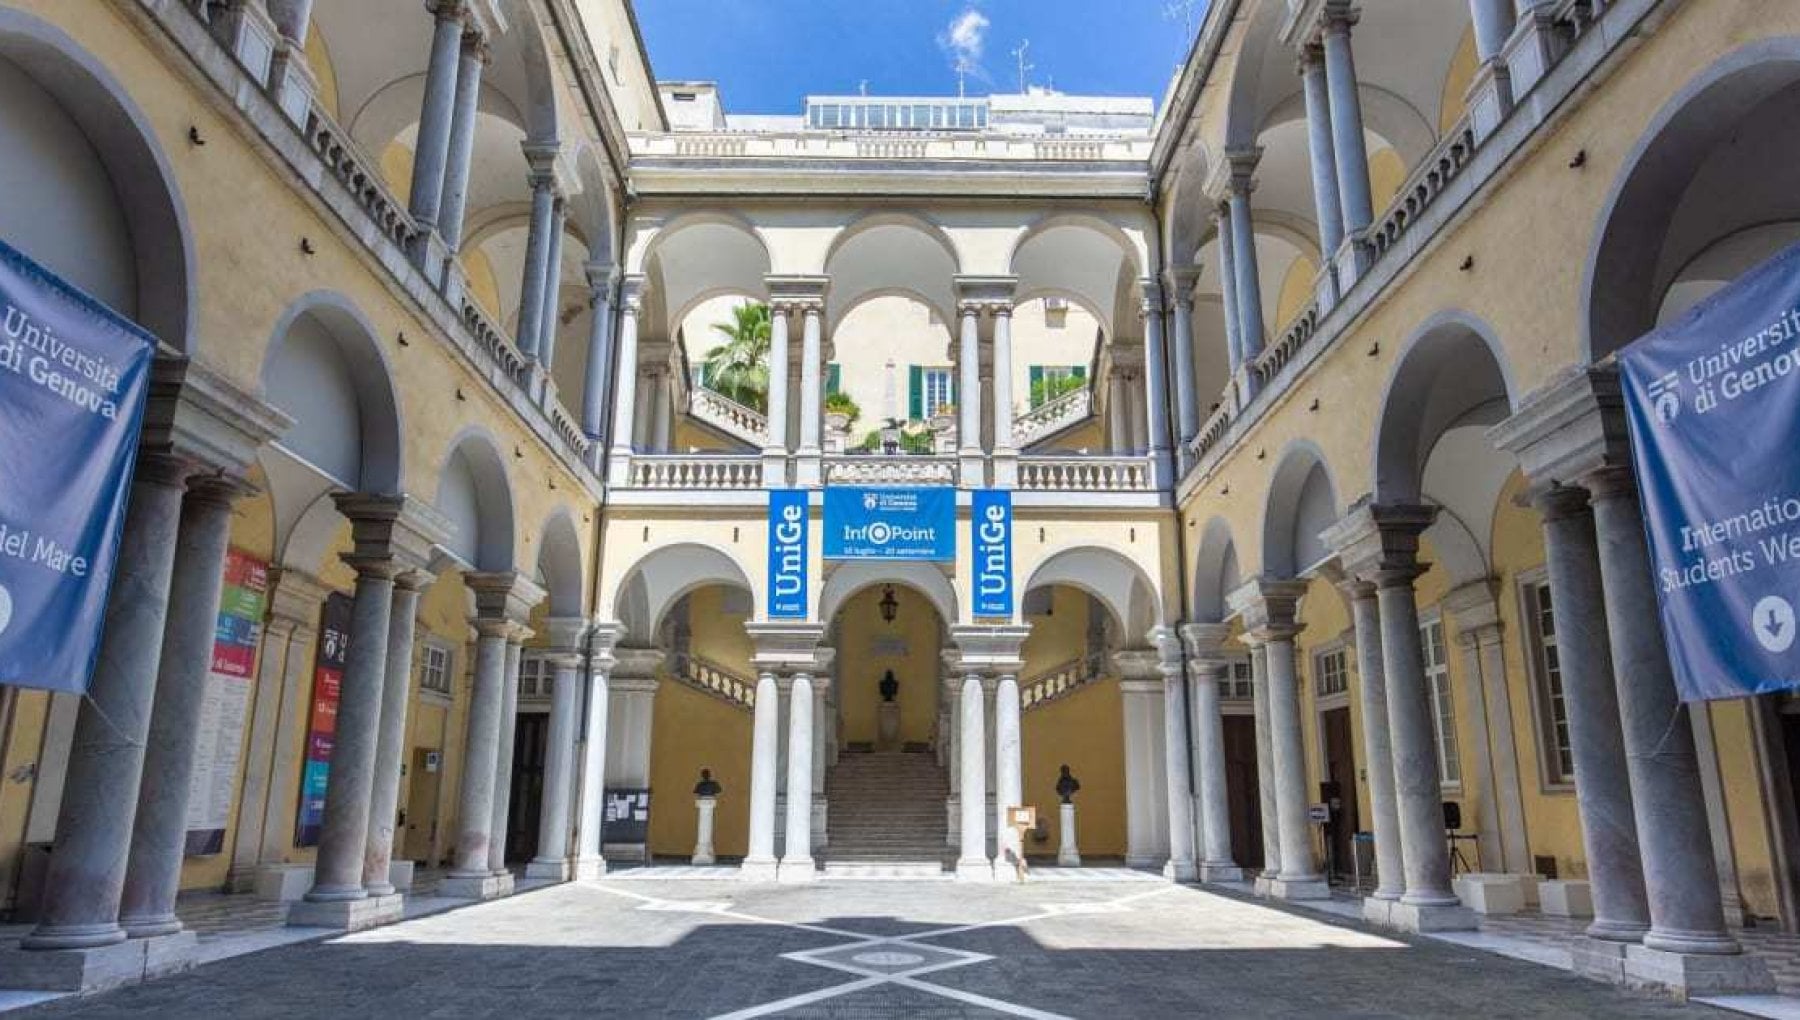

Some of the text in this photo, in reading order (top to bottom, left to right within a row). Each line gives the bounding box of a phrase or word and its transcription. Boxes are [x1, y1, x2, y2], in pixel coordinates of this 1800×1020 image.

[0, 340, 117, 421] di Genova
[1694, 381, 1718, 415] di
[32, 536, 87, 576] Mare
[775, 504, 801, 597] UniGe
[979, 504, 1006, 597] UniGe
[1659, 548, 1755, 594] Students
